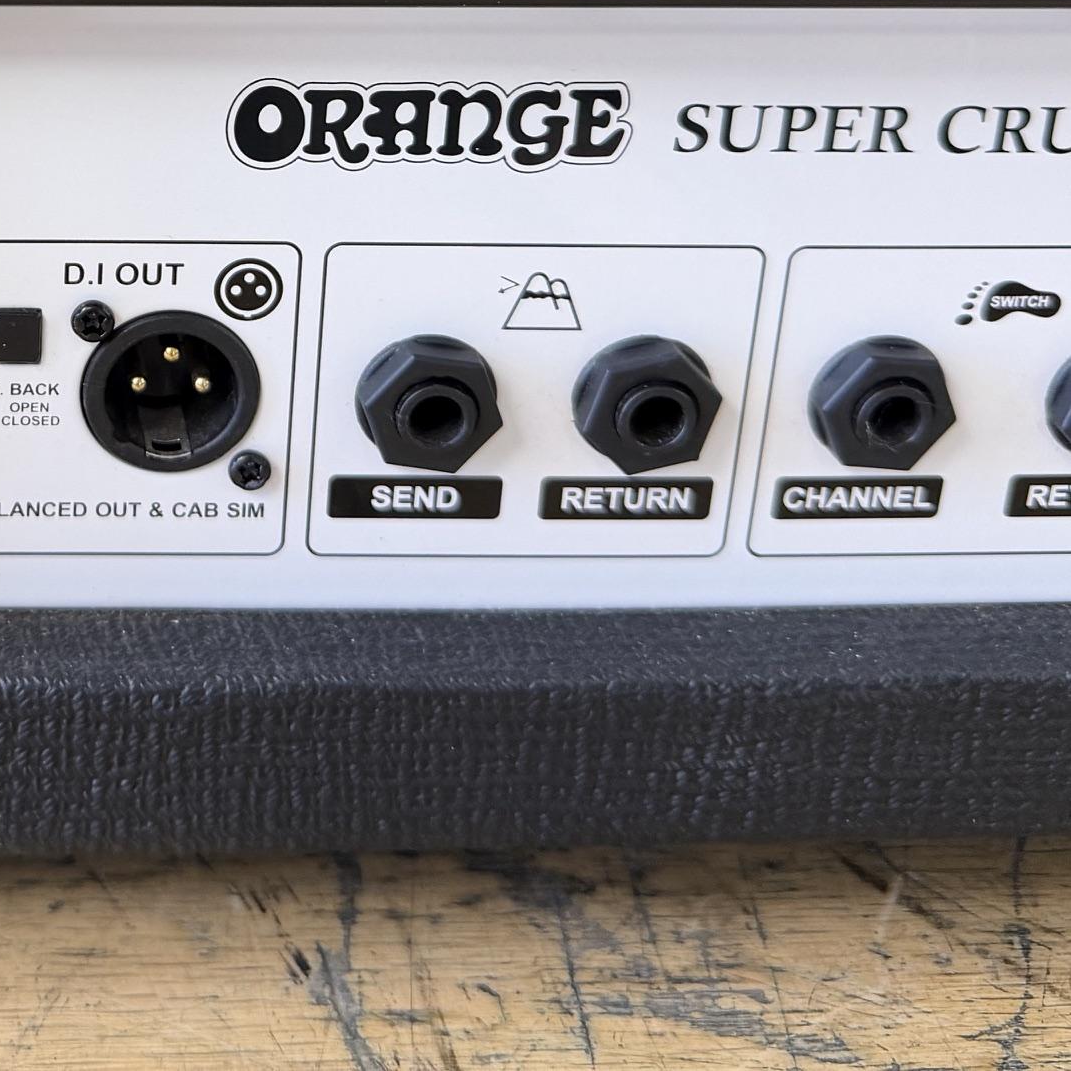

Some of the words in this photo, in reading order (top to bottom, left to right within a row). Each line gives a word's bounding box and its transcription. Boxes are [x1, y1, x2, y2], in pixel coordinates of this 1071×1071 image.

[233, 84, 627, 165] ORANGE
[672, 104, 914, 154] SUPER
[64, 263, 103, 285] D.I
[115, 263, 184, 285] OUT
[990, 295, 1049, 308] SWITCH
[11, 383, 59, 396] BACK
[10, 402, 49, 412] OPEN
[1, 415, 60, 426] CLOSED
[370, 485, 459, 512] SEND
[560, 487, 690, 513] RETURN
[782, 486, 932, 511] CHANNEL
[1025, 484, 1071, 508] RE
[96, 502, 141, 518] OUT
[149, 502, 164, 517] &
[172, 502, 219, 518] CAB
[227, 502, 265, 517] SIM
